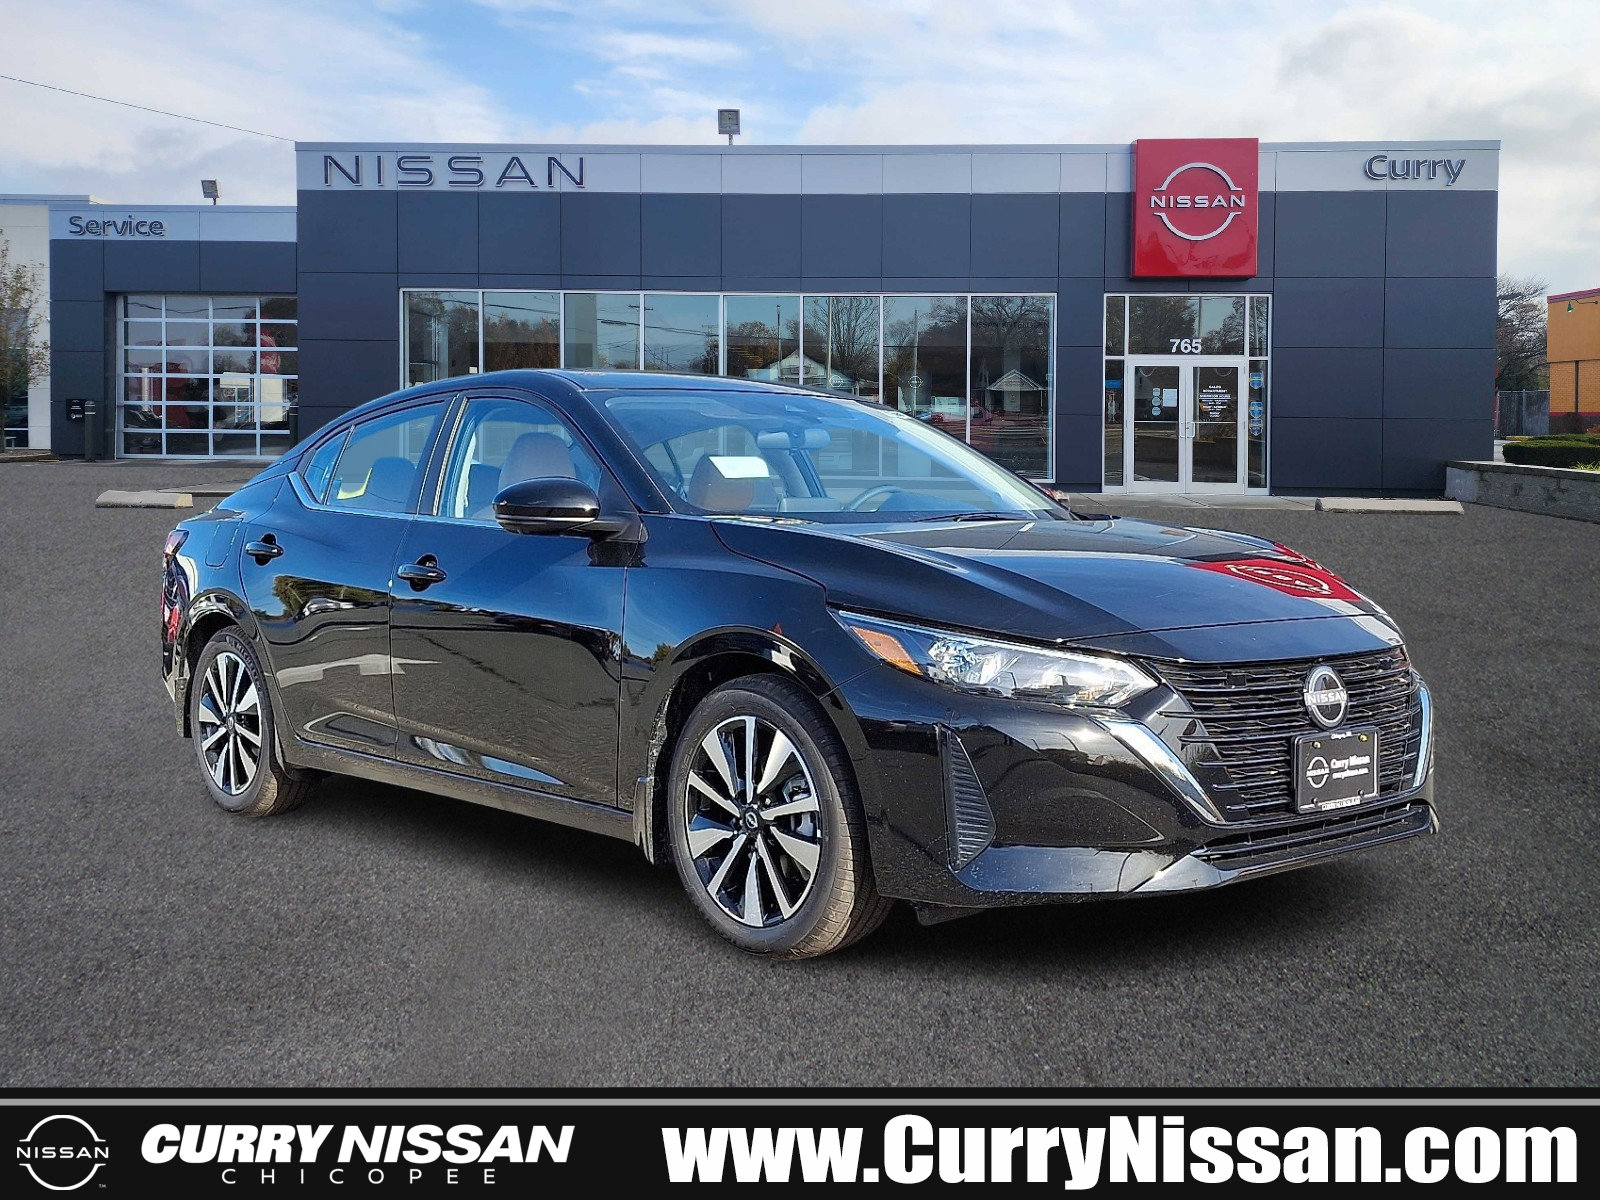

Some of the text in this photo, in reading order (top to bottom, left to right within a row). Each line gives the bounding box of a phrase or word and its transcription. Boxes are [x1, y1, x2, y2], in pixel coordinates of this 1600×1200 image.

[323, 155, 585, 188] NISSAN
[1364, 154, 1466, 186] Curry
[1150, 194, 1245, 208] NISSAN
[68, 214, 165, 236] Service
[1169, 338, 1203, 354] 765
[1306, 690, 1348, 705] NISSAN
